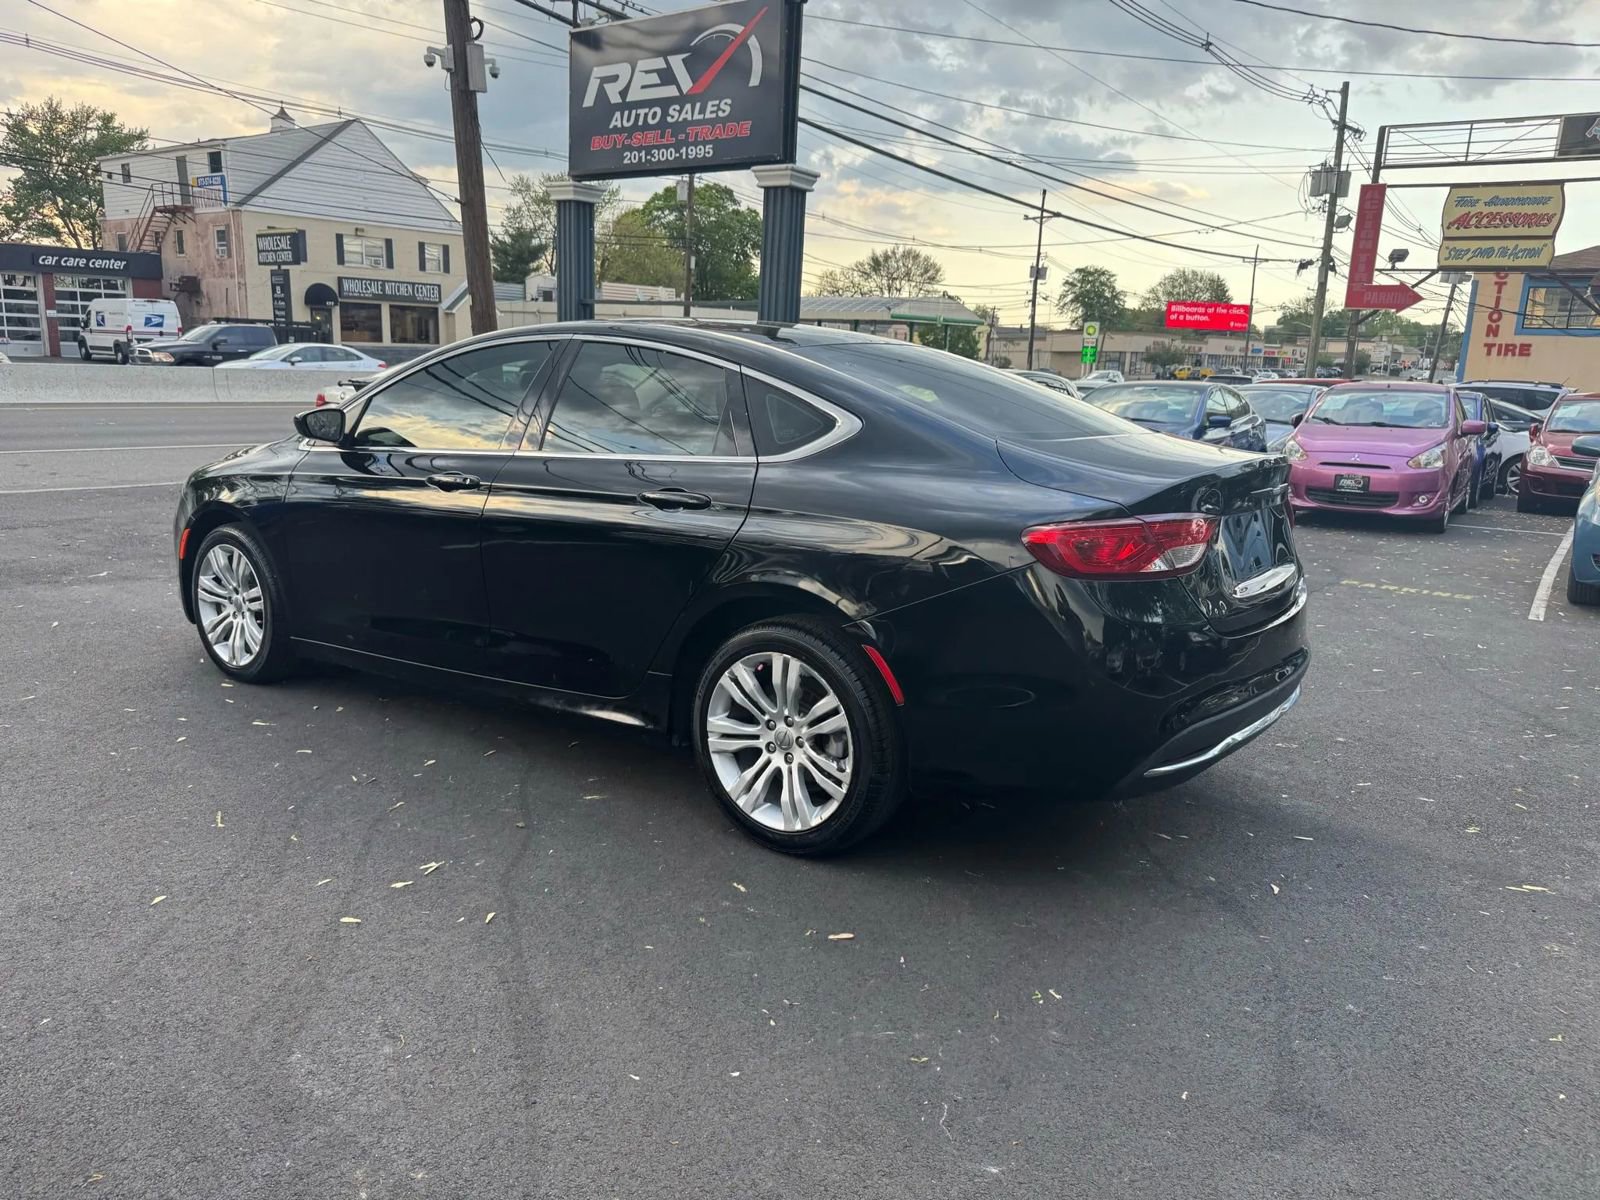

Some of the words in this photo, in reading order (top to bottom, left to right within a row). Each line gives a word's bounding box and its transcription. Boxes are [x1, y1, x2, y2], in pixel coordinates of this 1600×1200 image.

[609, 107, 661, 129] AUTO
[666, 98, 732, 122] SALES
[623, 144, 713, 164] 201-300-1995
[1446, 211, 1557, 230] ACCESSORIES
[257, 235, 292, 251] WHOLESALE
[38, 255, 59, 266] car
[60, 256, 87, 268] care
[88, 258, 127, 270] center
[259, 251, 276, 263] KITCHEN
[276, 250, 293, 262] CENTER
[342, 278, 383, 295] WHOLESALE
[385, 280, 413, 297] KITCHEN
[414, 284, 440, 299] CENTER
[1170, 304, 1206, 313] Billboards
[1216, 306, 1228, 314] the
[1169, 313, 1178, 321] of
[1483, 342, 1532, 357] TIRE
